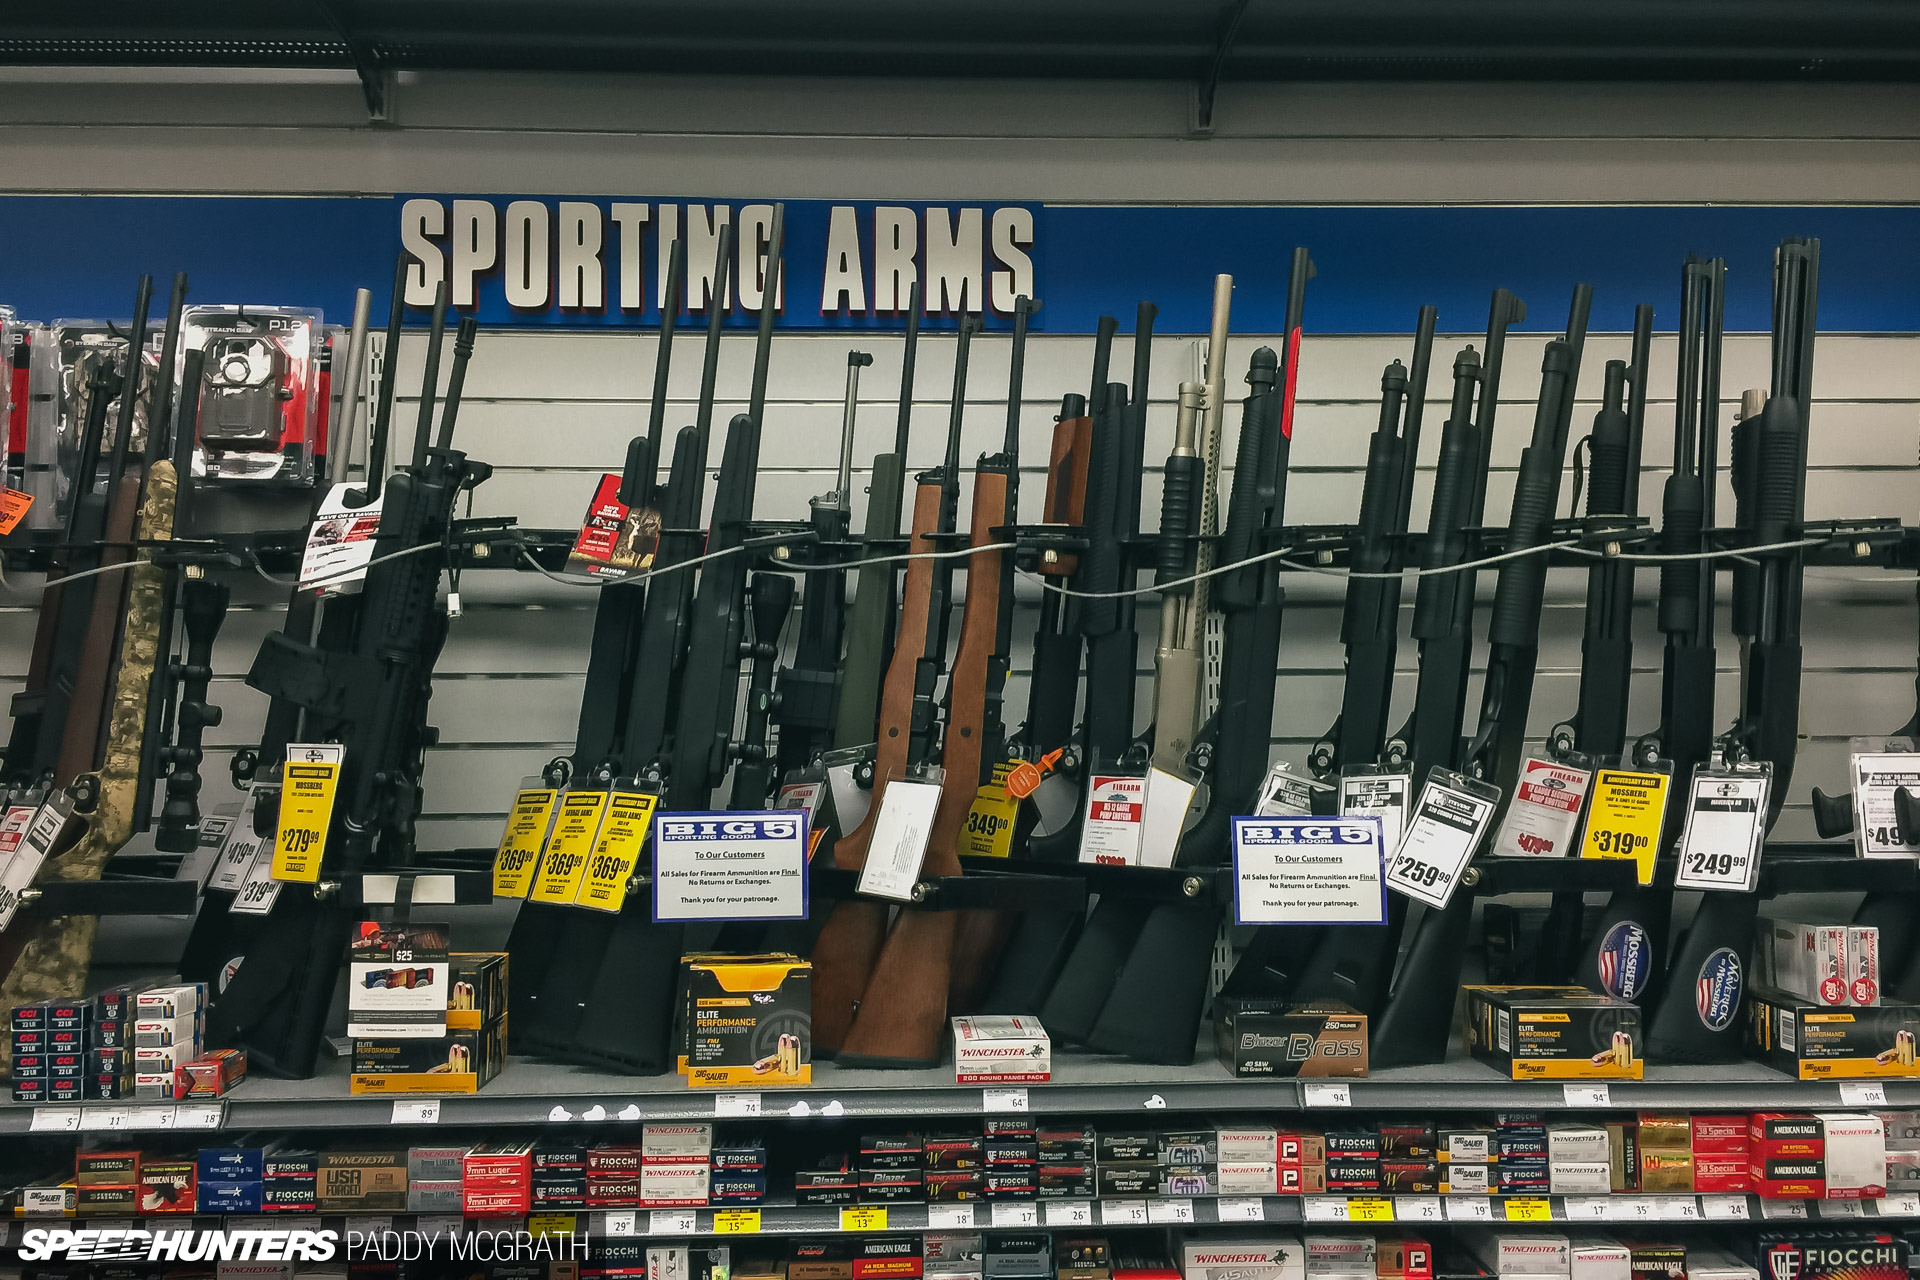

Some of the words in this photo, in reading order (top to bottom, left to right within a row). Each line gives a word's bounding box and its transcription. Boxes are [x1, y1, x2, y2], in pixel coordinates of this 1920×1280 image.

[401, 199, 782, 311] SPORTING
[822, 205, 1034, 312] ARMS
[1549, 770, 1583, 784] FIREARM
[295, 781, 323, 791] MOSSBERG
[1112, 783, 1141, 792] FIREARM
[1550, 788, 1577, 803] SECURITY
[1610, 788, 1647, 798] MOSSBERG
[664, 821, 757, 836] BIG
[763, 821, 795, 839] 5
[1244, 827, 1333, 839] BIG
[1340, 826, 1371, 843] 5
[1593, 829, 1649, 855] $31900
[706, 851, 721, 859] Our
[723, 851, 766, 859] Customers
[1301, 855, 1343, 863] Customers
[1686, 852, 1746, 876] $24999
[701, 869, 726, 877] Firearm
[727, 869, 769, 877] Ammunition
[1397, 855, 1452, 887] $25999
[735, 878, 772, 887] Exchanges.
[1314, 882, 1350, 890] Exchanges.
[681, 896, 701, 904] Thank
[727, 897, 743, 905] your
[743, 896, 780, 904] patronage.
[1323, 901, 1359, 909] patronage.
[396, 950, 413, 961] $25
[1622, 925, 1643, 999] MOSSBERG
[1716, 952, 1740, 1028] MAVERICK
[19, 1010, 37, 1018] CCI
[56, 1009, 73, 1017] CCI
[696, 1010, 719, 1018] ELITE
[696, 1018, 757, 1027] PERFORMANCE
[1325, 1021, 1340, 1030] 250
[696, 1026, 748, 1034] AMMUNITION
[19, 1033, 37, 1042] CCI
[1286, 1032, 1363, 1062] Brass
[960, 1047, 1026, 1057] WINCHESTER
[695, 1070, 707, 1078] SIG
[705, 1072, 729, 1080] SAUER
[20, 1081, 38, 1090] CCI
[55, 1081, 73, 1089] CCI
[1709, 1127, 1736, 1136] Special
[1773, 1126, 1800, 1134] AMERICAN
[1800, 1125, 1816, 1134] EAGLE
[875, 1140, 907, 1150] Blazer
[1339, 1138, 1375, 1146] FIOCCHI
[1453, 1137, 1465, 1145] SIG
[1463, 1139, 1483, 1147] SAUER
[327, 1155, 395, 1165] WINCHESTER
[600, 1157, 637, 1165] FIOCCHI
[466, 1166, 486, 1174] 9mm
[488, 1166, 511, 1175] Luger
[645, 1169, 696, 1177] WINCHESTER
[1339, 1168, 1376, 1176] FIOCCHI
[1453, 1168, 1465, 1176] SIG
[1462, 1170, 1483, 1178] SAUER
[1709, 1164, 1737, 1173] Special
[1774, 1166, 1801, 1174] AMERICAN
[1801, 1166, 1817, 1174] EAGLE
[142, 1175, 170, 1184] AMERICAN
[170, 1174, 188, 1183] EAGLE
[326, 1169, 362, 1184] USA
[812, 1176, 845, 1186] Blazer
[873, 1173, 906, 1183] Blazer
[326, 1184, 361, 1196] FORGED
[599, 1185, 637, 1193] FIOCCHI
[276, 1191, 314, 1199] FIOCCHI
[489, 1197, 512, 1206] Luger
[864, 1245, 894, 1253] AMERICAN
[894, 1244, 911, 1252] EAGLE
[1194, 1253, 1267, 1264] WINCHESTER
[1805, 1248, 1897, 1265] FIOCCHI
[1631, 1261, 1664, 1271] AMERICAN
